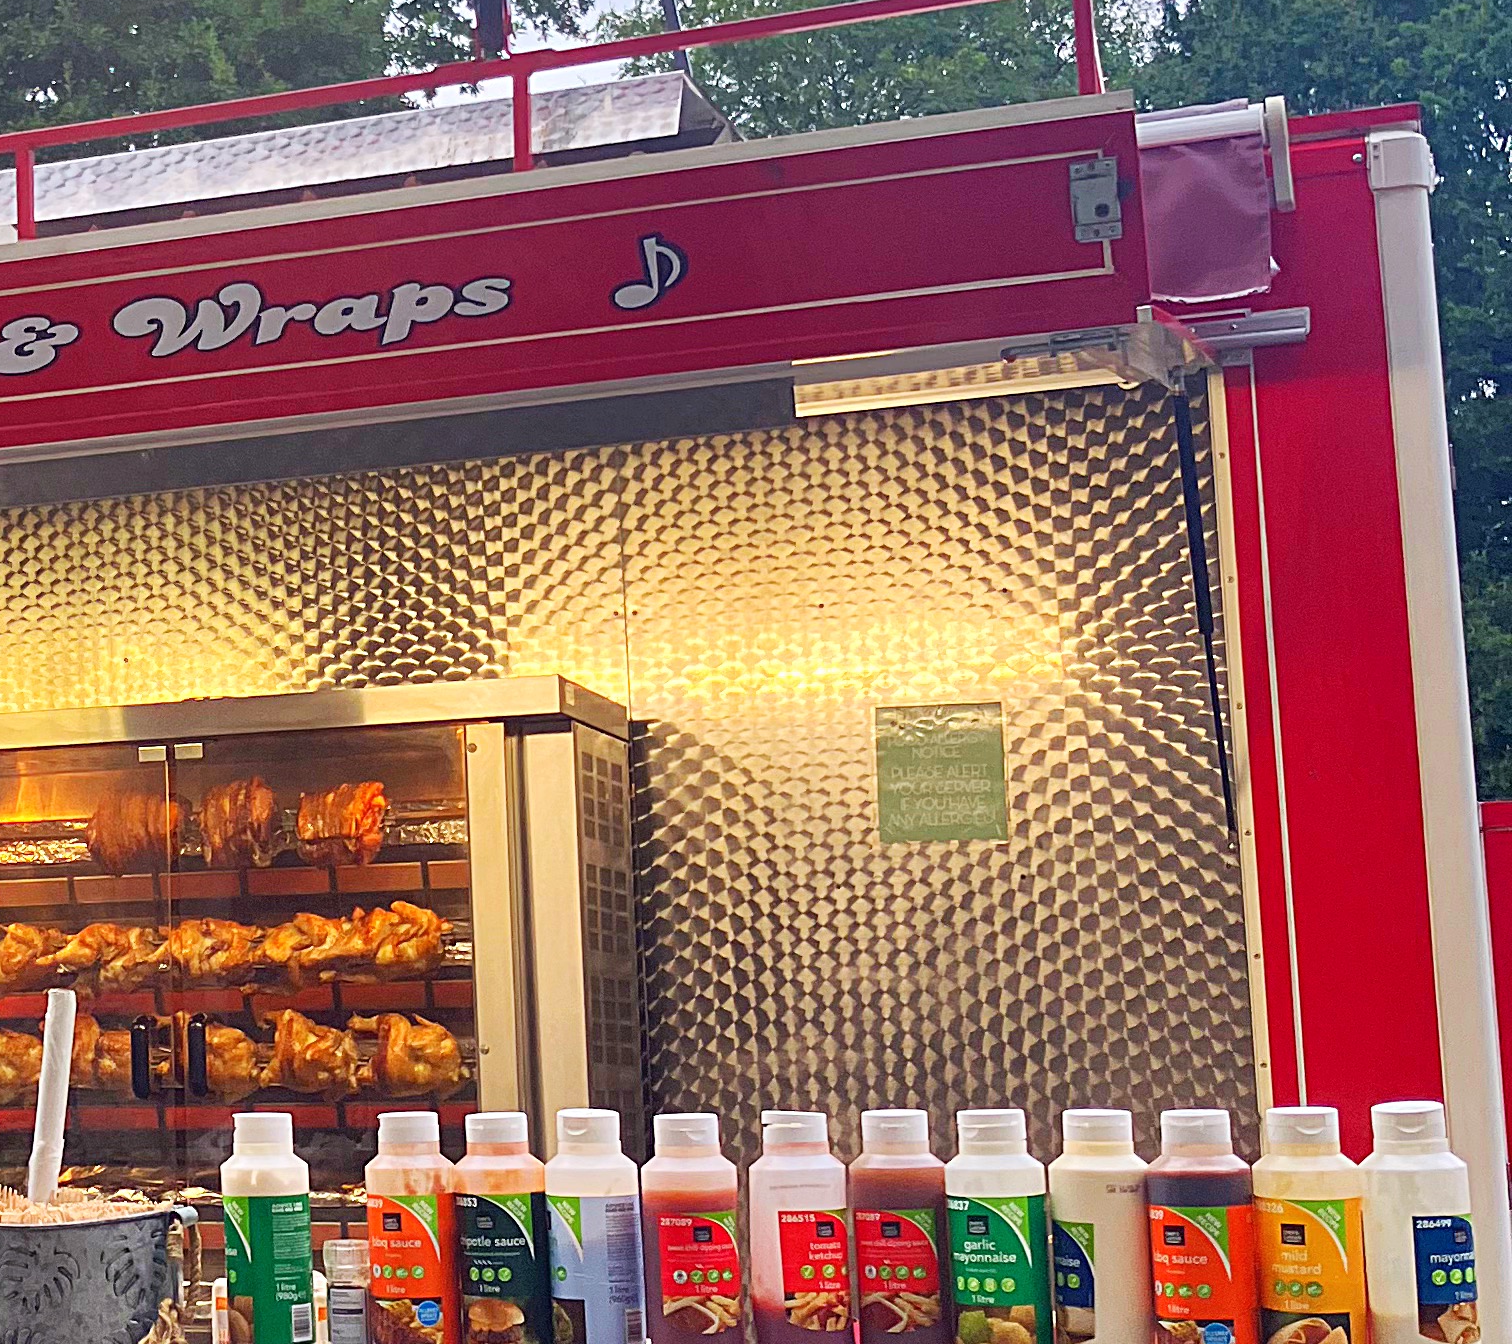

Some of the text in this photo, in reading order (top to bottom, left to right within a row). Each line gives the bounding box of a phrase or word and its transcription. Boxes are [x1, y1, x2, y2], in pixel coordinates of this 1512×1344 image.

[113, 278, 511, 359] Wraps
[912, 745, 962, 760] NOTICE
[891, 763, 988, 779] PLEASE ALERT
[890, 782, 932, 795] YOUR
[948, 795, 987, 810] HAVE
[390, 1237, 422, 1248] sauce
[494, 1235, 526, 1247] sauce
[963, 1239, 997, 1253] garlic
[953, 1251, 1018, 1265] mayonnaise
[1172, 1254, 1209, 1266] sauce
[1281, 1249, 1308, 1262] mild
[1272, 1262, 1322, 1276] mustard
